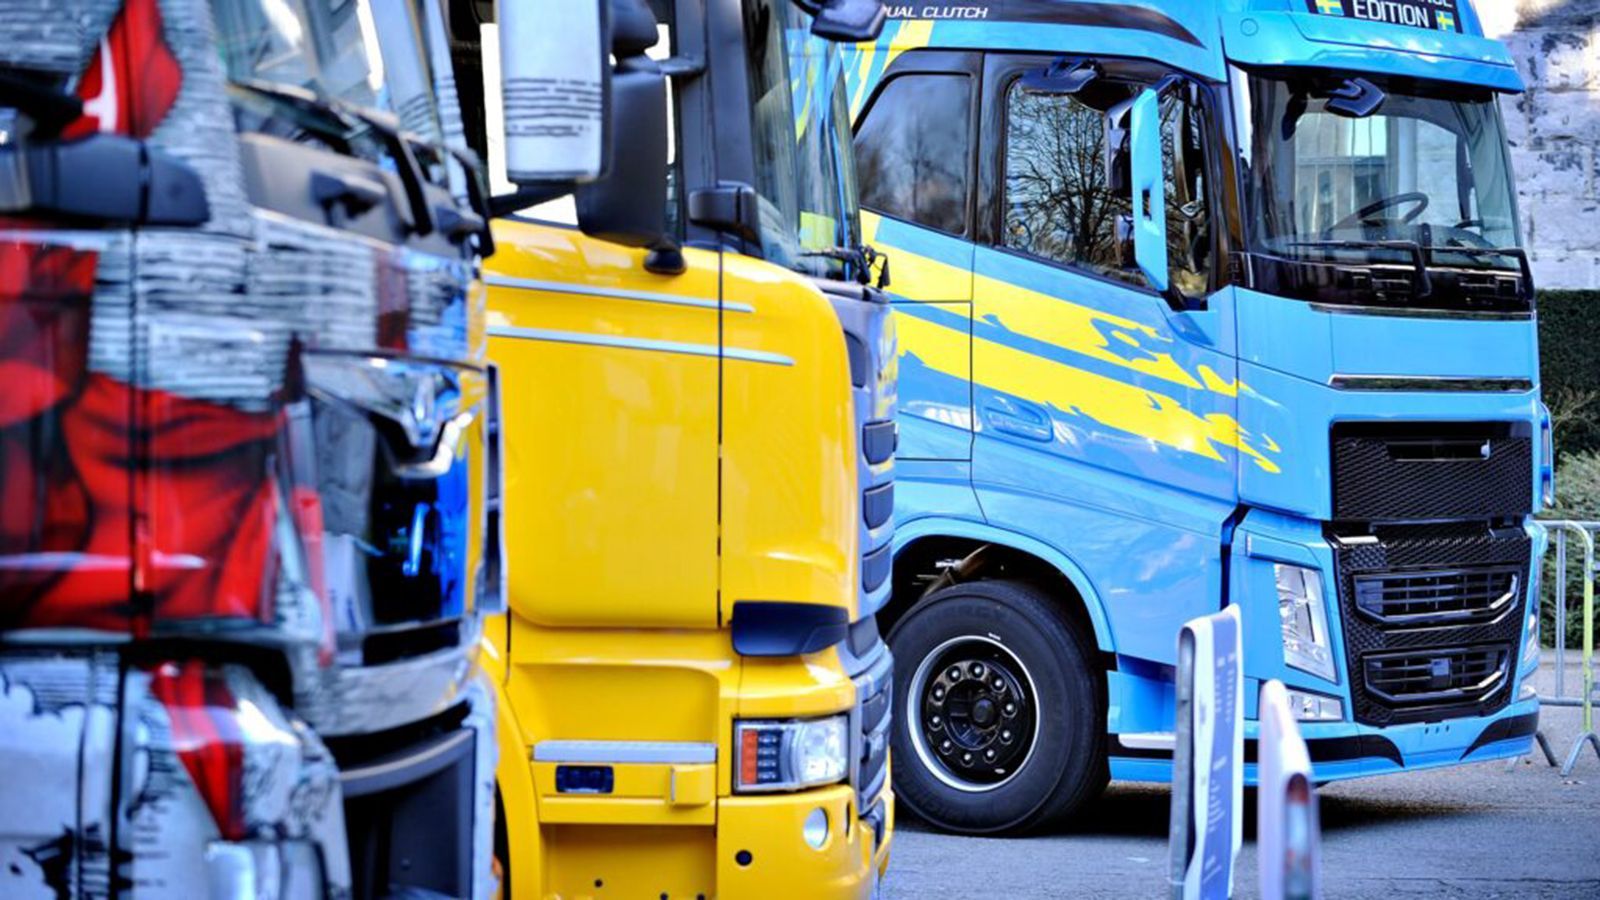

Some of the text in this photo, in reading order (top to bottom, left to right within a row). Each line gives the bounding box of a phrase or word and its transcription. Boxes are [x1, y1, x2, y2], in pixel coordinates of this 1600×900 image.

[884, 6, 988, 18] UAL CLUTCH
[1352, 0, 1430, 27] EDITION
